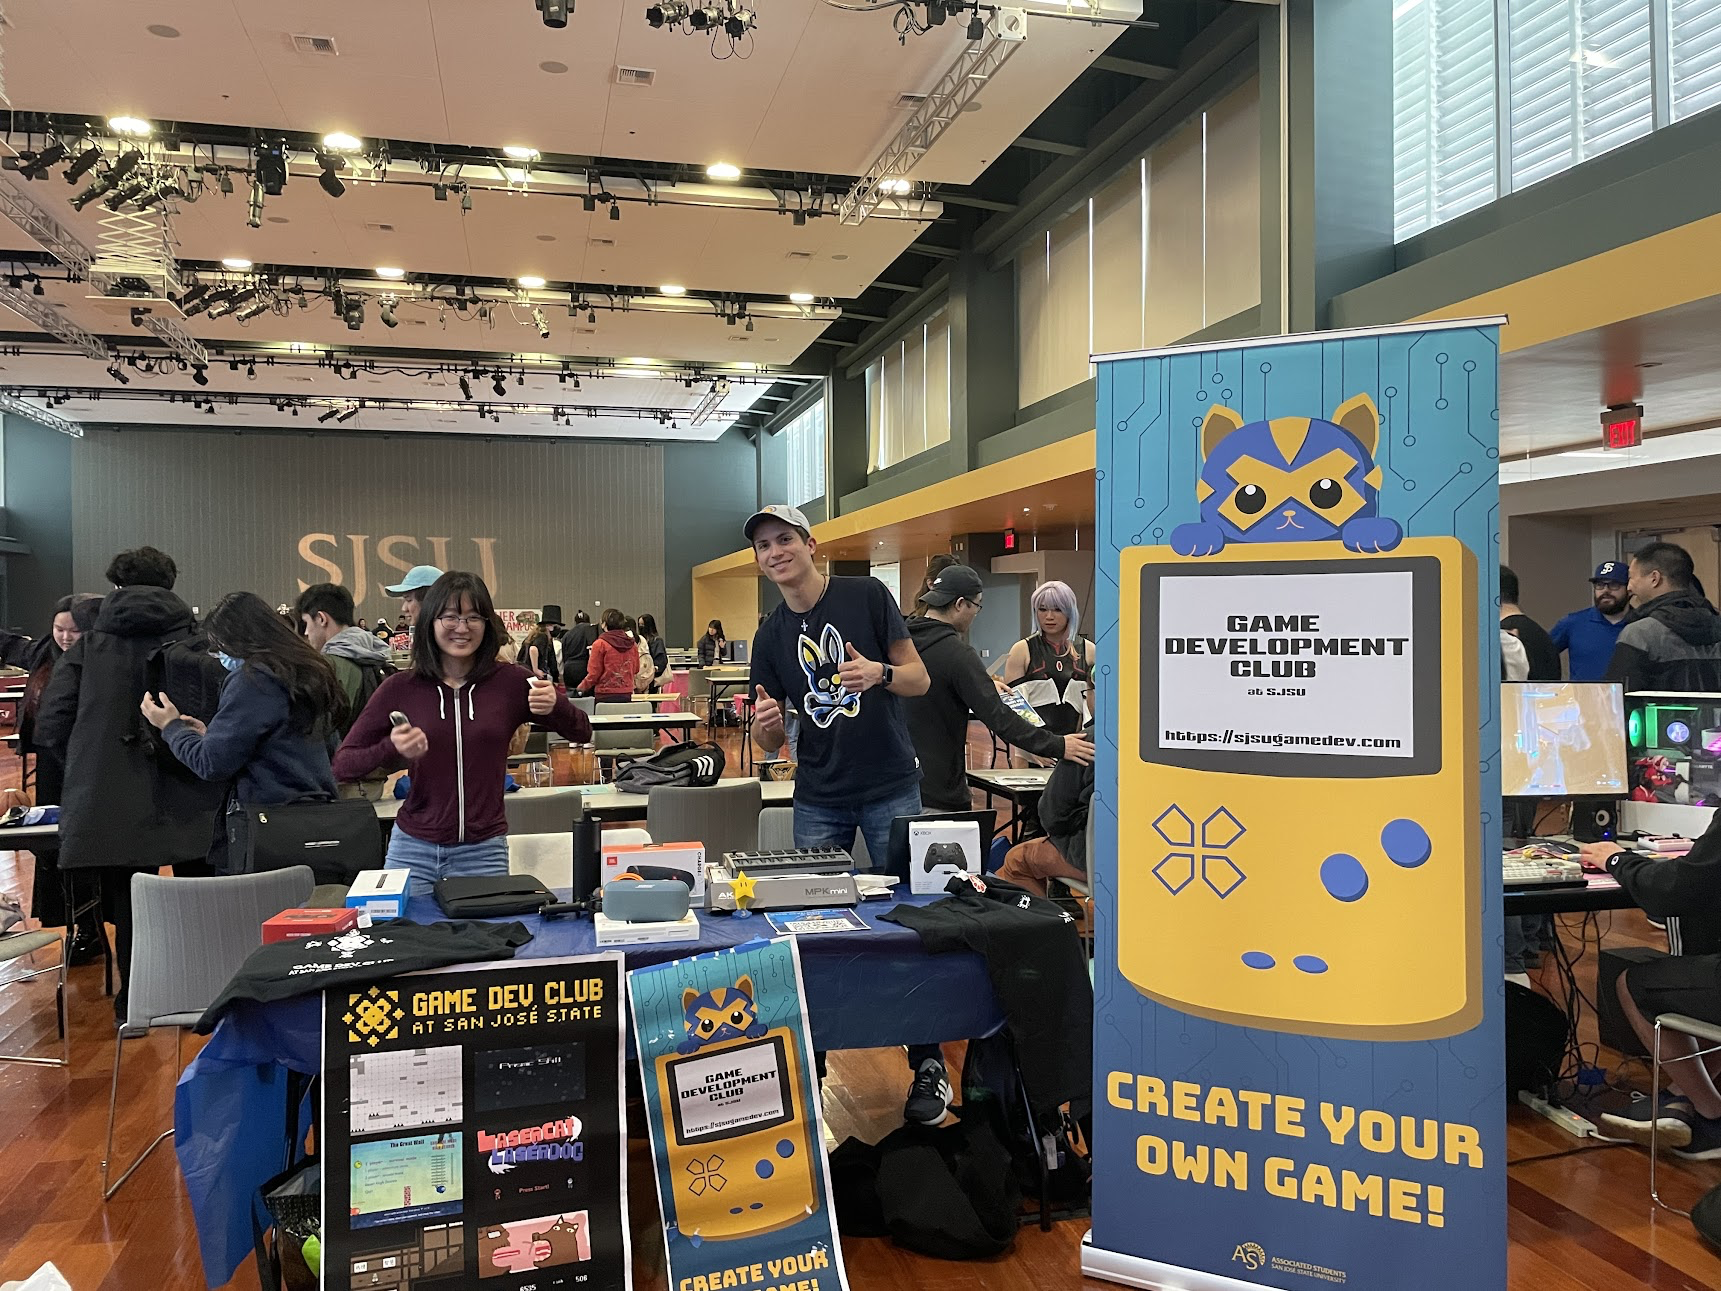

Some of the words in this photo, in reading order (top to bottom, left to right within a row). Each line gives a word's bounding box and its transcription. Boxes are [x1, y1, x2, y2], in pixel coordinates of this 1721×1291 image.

[1609, 420, 1636, 448] EXIT
[1226, 614, 1320, 633] GAME
[1164, 637, 1409, 656] DEVELOPMENT
[1230, 660, 1316, 678] CLUB
[1247, 688, 1263, 696] at
[1266, 688, 1306, 696] SJSU
[1165, 730, 1401, 748] https://sjsugamedev.com
[413, 988, 477, 1016] GAME
[488, 983, 534, 1010] DEV
[545, 978, 603, 1004] CLUB
[412, 1021, 434, 1035] AT
[444, 1016, 484, 1031] SAN
[490, 1005, 538, 1028] JOSÉ
[546, 1005, 602, 1022] STATE
[681, 1070, 777, 1099] DEVELOPMENT
[705, 1068, 743, 1084] GAME
[709, 1087, 744, 1102] CLUB
[686, 1109, 779, 1134] https://sjsugamedev.com
[1106, 1070, 1306, 1138] CREATE
[1319, 1101, 1484, 1169] YOUR
[1136, 1134, 1249, 1191] OWN
[1264, 1156, 1445, 1228] GAME!
[680, 1263, 764, 1291] CREATE
[767, 1250, 829, 1278] YOUR
[1271, 1256, 1312, 1270] ASSOCIATED
[1312, 1265, 1347, 1278] STUDENTS
[1297, 1268, 1313, 1277] STATE
[1313, 1272, 1346, 1284] UNIVERSITY
